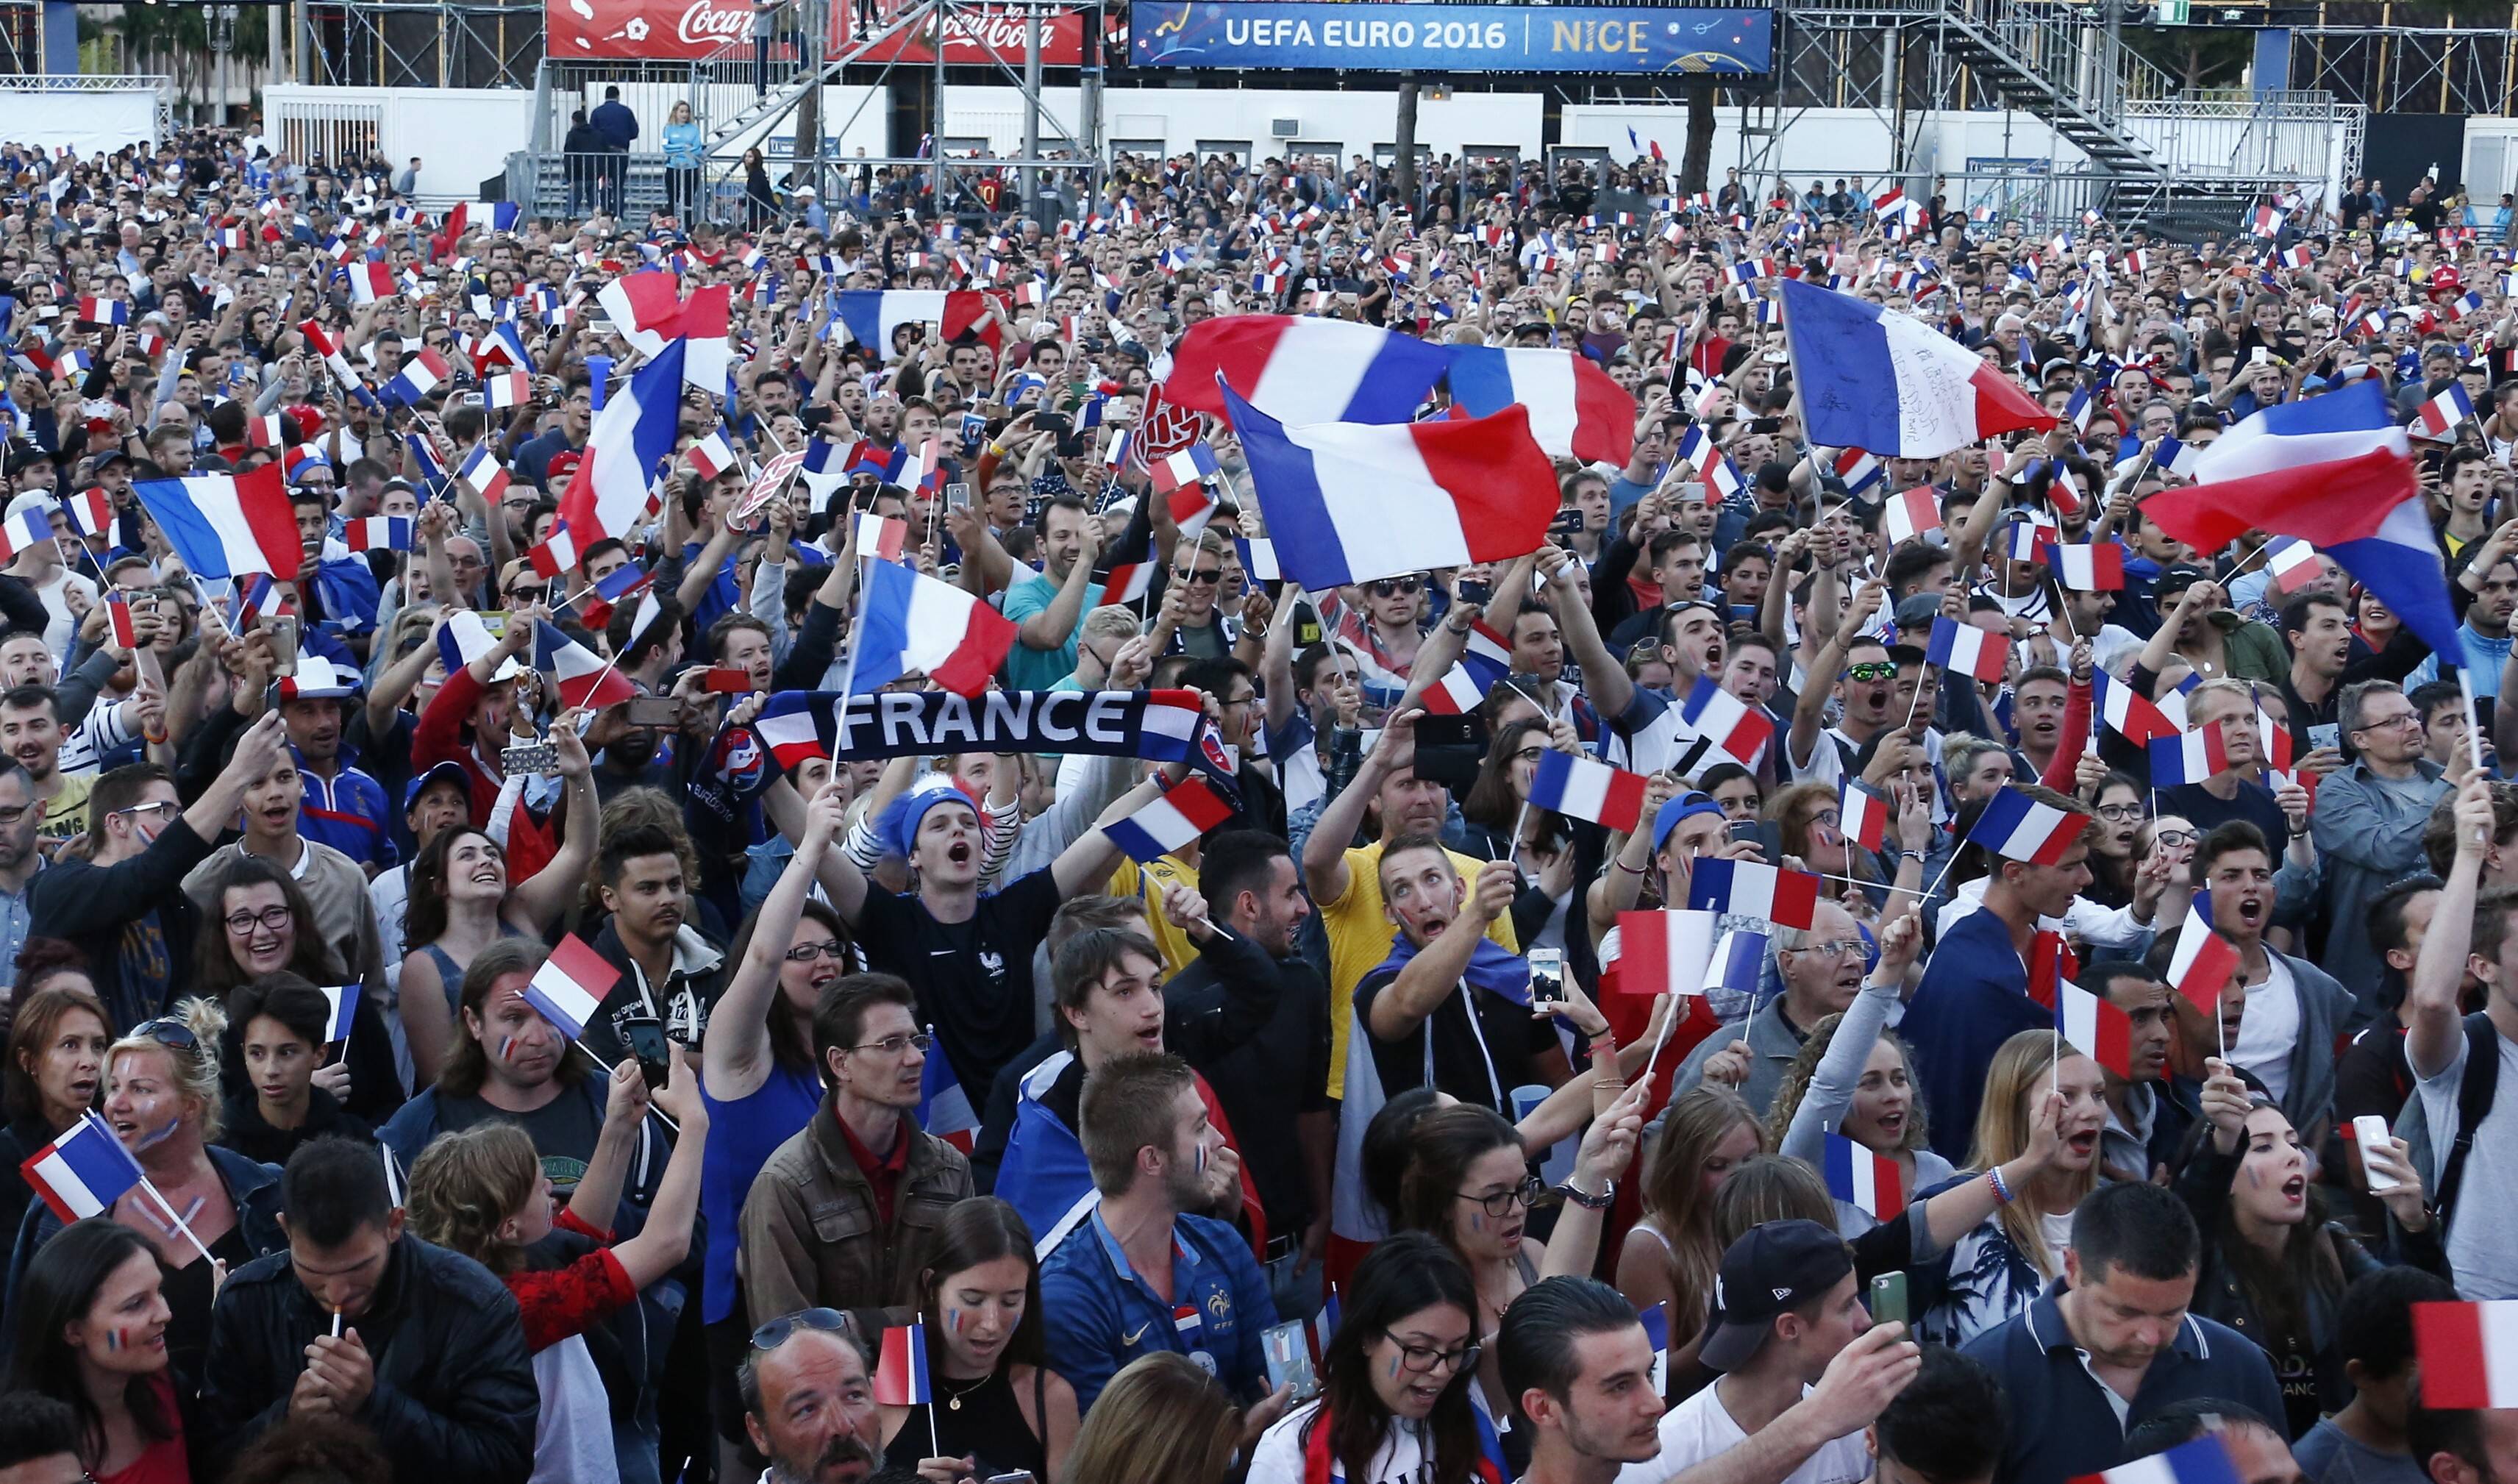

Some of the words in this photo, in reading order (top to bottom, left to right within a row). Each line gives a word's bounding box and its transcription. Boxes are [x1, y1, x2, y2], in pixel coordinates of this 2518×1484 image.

[1225, 18, 1316, 47] UEFA
[1323, 20, 1415, 49] EURO
[1422, 21, 1507, 49] 2016
[1550, 19, 1650, 54] NICE
[832, 690, 1133, 751] FRANCE
[1214, 1320, 1234, 1330] FFF
